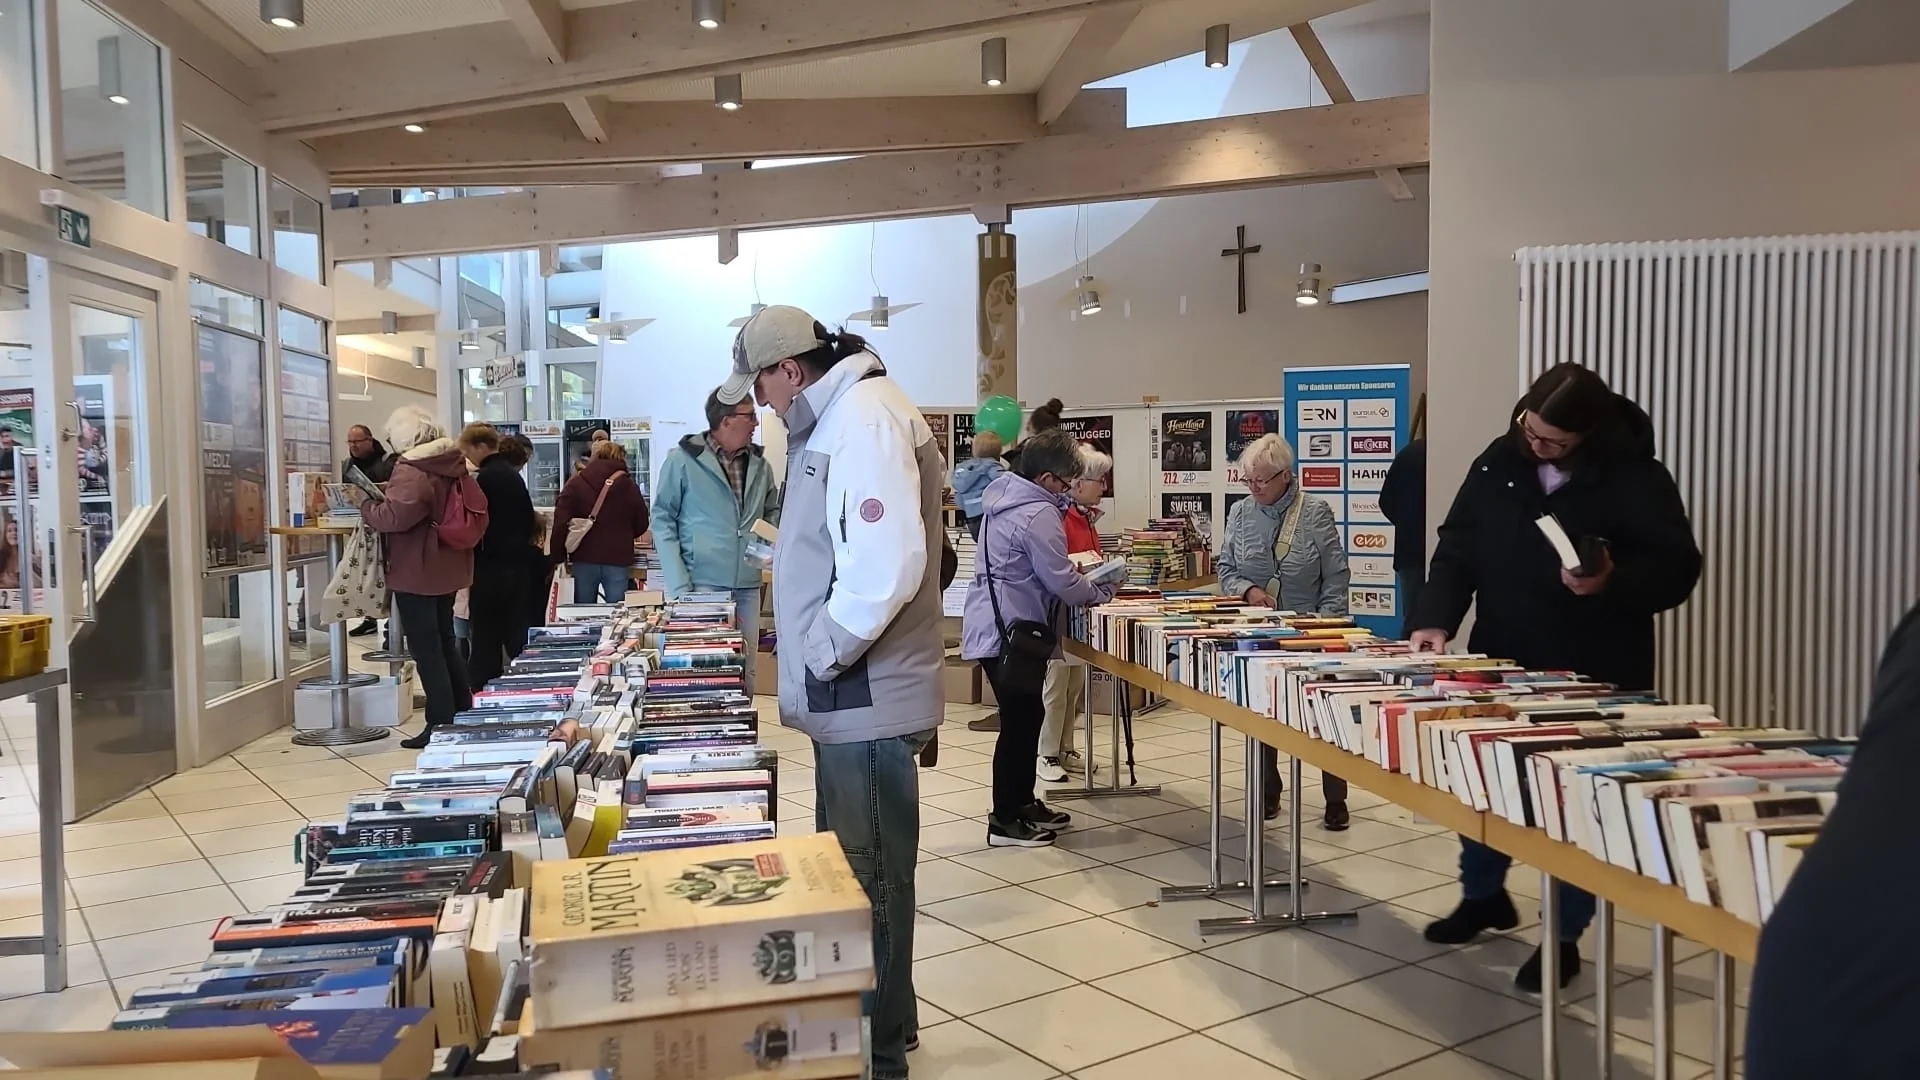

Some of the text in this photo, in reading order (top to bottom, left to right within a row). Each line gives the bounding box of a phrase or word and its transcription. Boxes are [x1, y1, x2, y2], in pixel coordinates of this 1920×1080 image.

[1360, 382, 1396, 390] Sponsoren
[1060, 421, 1085, 431] IMPLY
[1166, 418, 1205, 433] Heartland
[1069, 429, 1111, 440] PLUGGED
[1353, 438, 1389, 452] BECKER
[1170, 500, 1203, 512] SWEDEN
[1355, 536, 1385, 546] evm
[1092, 673, 1102, 681] 29
[585, 857, 647, 932] MARTIN
[561, 889, 585, 927] GEORGE
[665, 940, 678, 997] DAS LIED
[679, 952, 692, 983] VON
[707, 943, 720, 983] FEUER
[618, 945, 636, 1003] MARTIN
